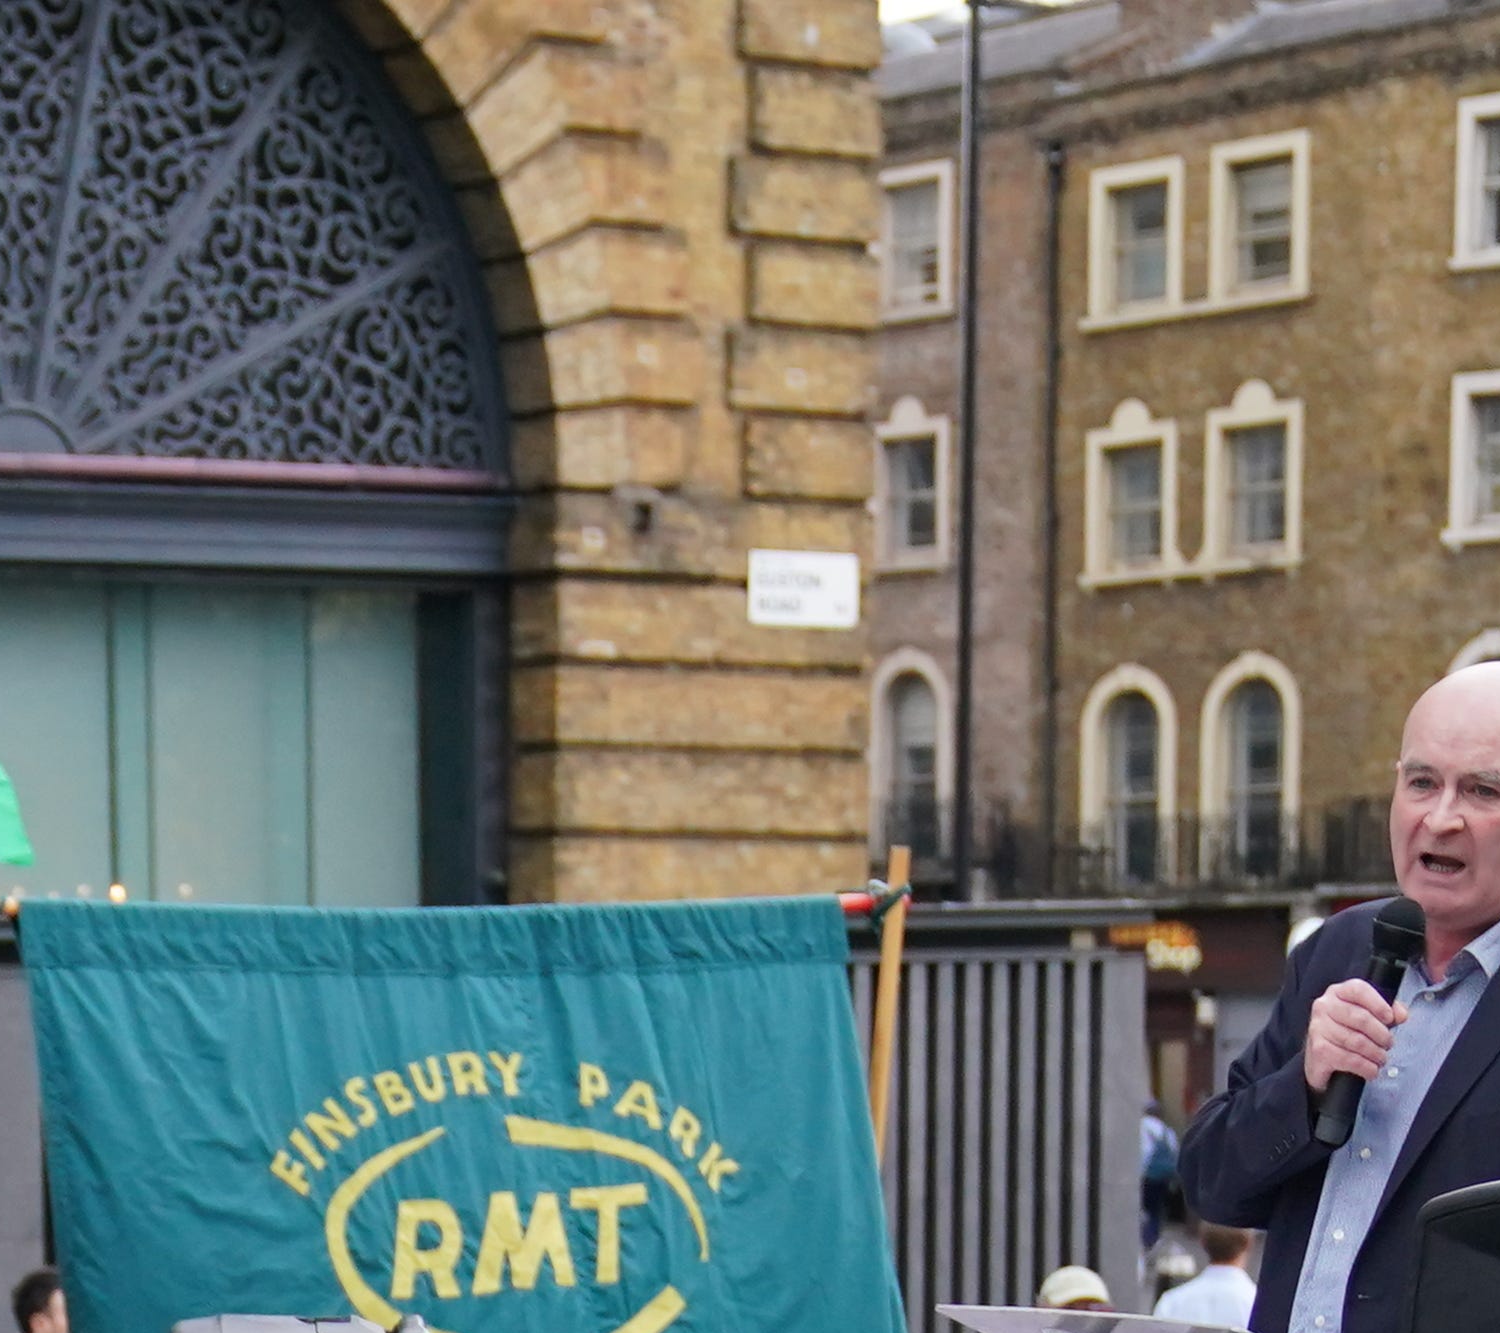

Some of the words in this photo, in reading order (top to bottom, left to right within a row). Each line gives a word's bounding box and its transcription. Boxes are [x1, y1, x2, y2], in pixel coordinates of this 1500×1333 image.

[269, 1051, 525, 1196] FINSBURY
[577, 1062, 742, 1193] PARK
[390, 1183, 649, 1299] RMT
